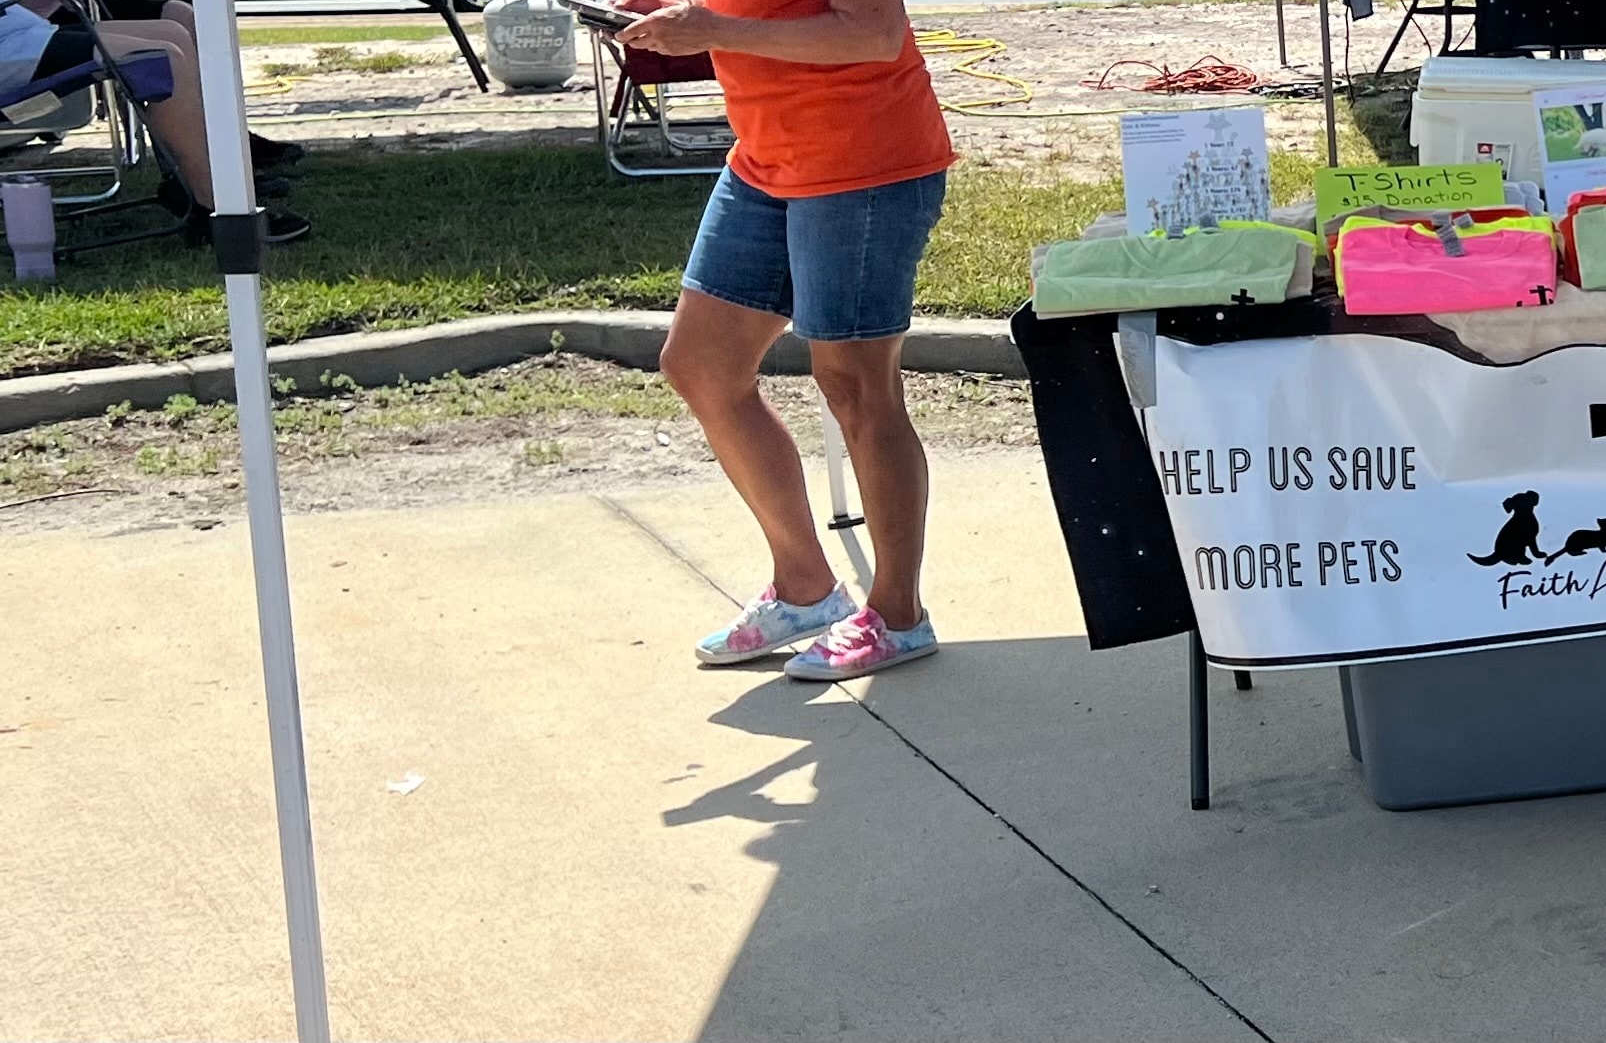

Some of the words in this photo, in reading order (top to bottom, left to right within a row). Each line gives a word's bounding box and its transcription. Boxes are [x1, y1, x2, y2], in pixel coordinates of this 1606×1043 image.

[511, 24, 555, 36] Blue
[510, 36, 564, 49] Rhino
[1334, 168, 1477, 192] T-Shirts
[1341, 194, 1375, 207] $15
[1386, 190, 1473, 206] Donation
[1158, 447, 1251, 495] HELP
[1268, 446, 1314, 491] US
[1327, 446, 1416, 491] SAVE
[1194, 543, 1303, 591] MORE
[1317, 539, 1402, 587] PETS
[1496, 570, 1590, 610] Faith
